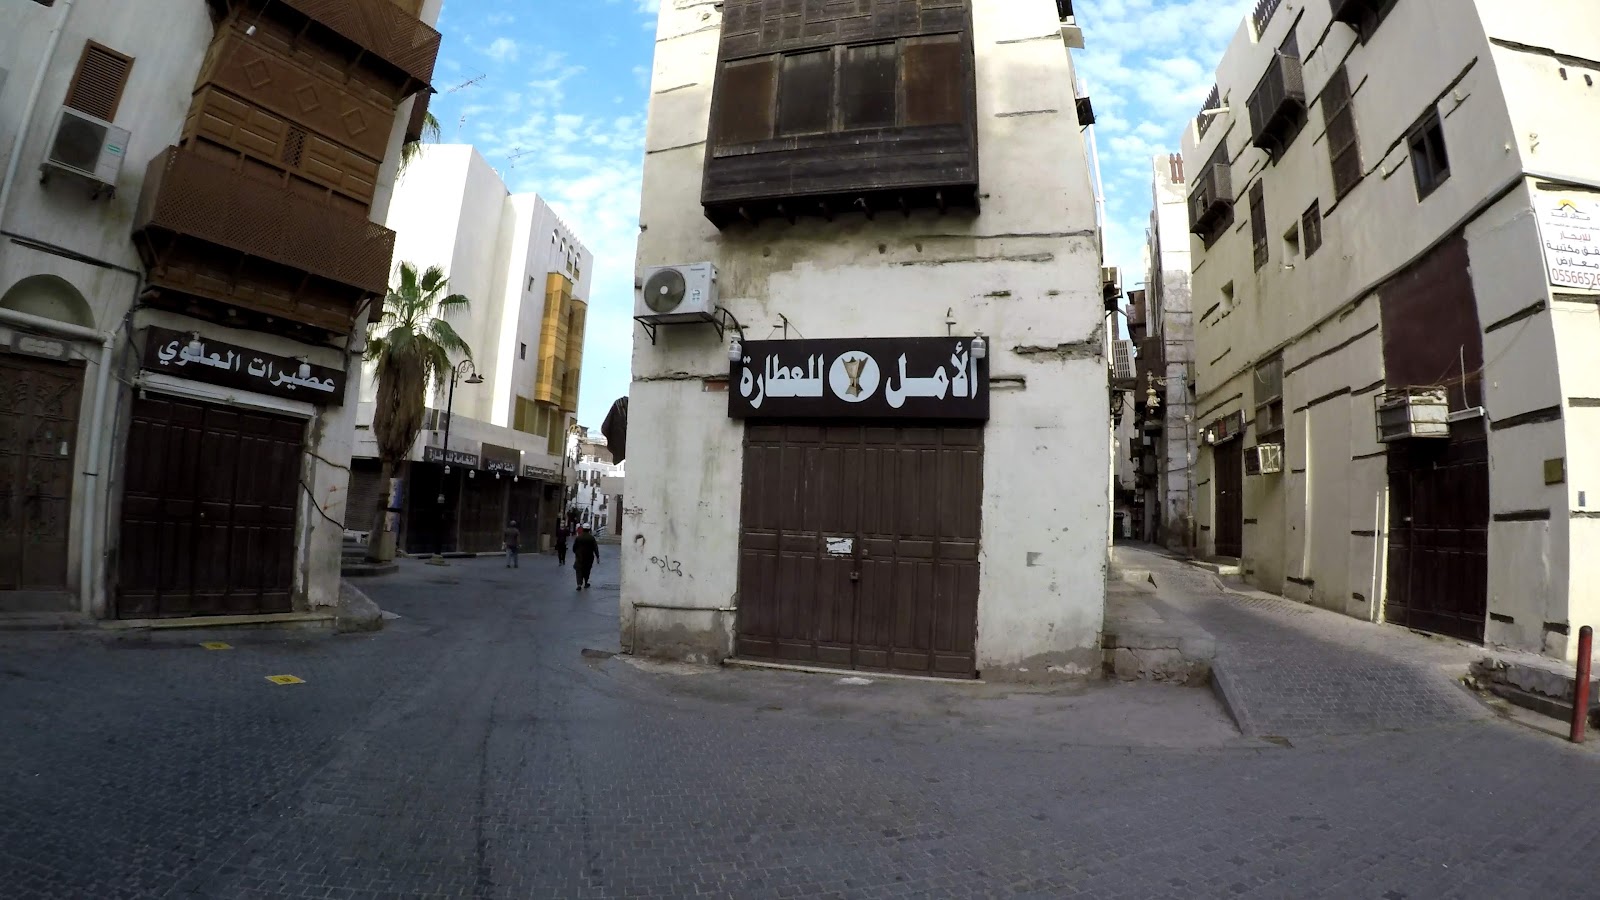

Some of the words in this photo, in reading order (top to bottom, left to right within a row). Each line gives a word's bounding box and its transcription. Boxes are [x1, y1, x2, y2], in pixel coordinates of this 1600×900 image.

[1556, 256, 1599, 269] معارض
[1581, 245, 1600, 257] قق
[158, 340, 241, 372] العلوي
[739, 353, 824, 409] للعطارة
[885, 341, 978, 409] الأمل
